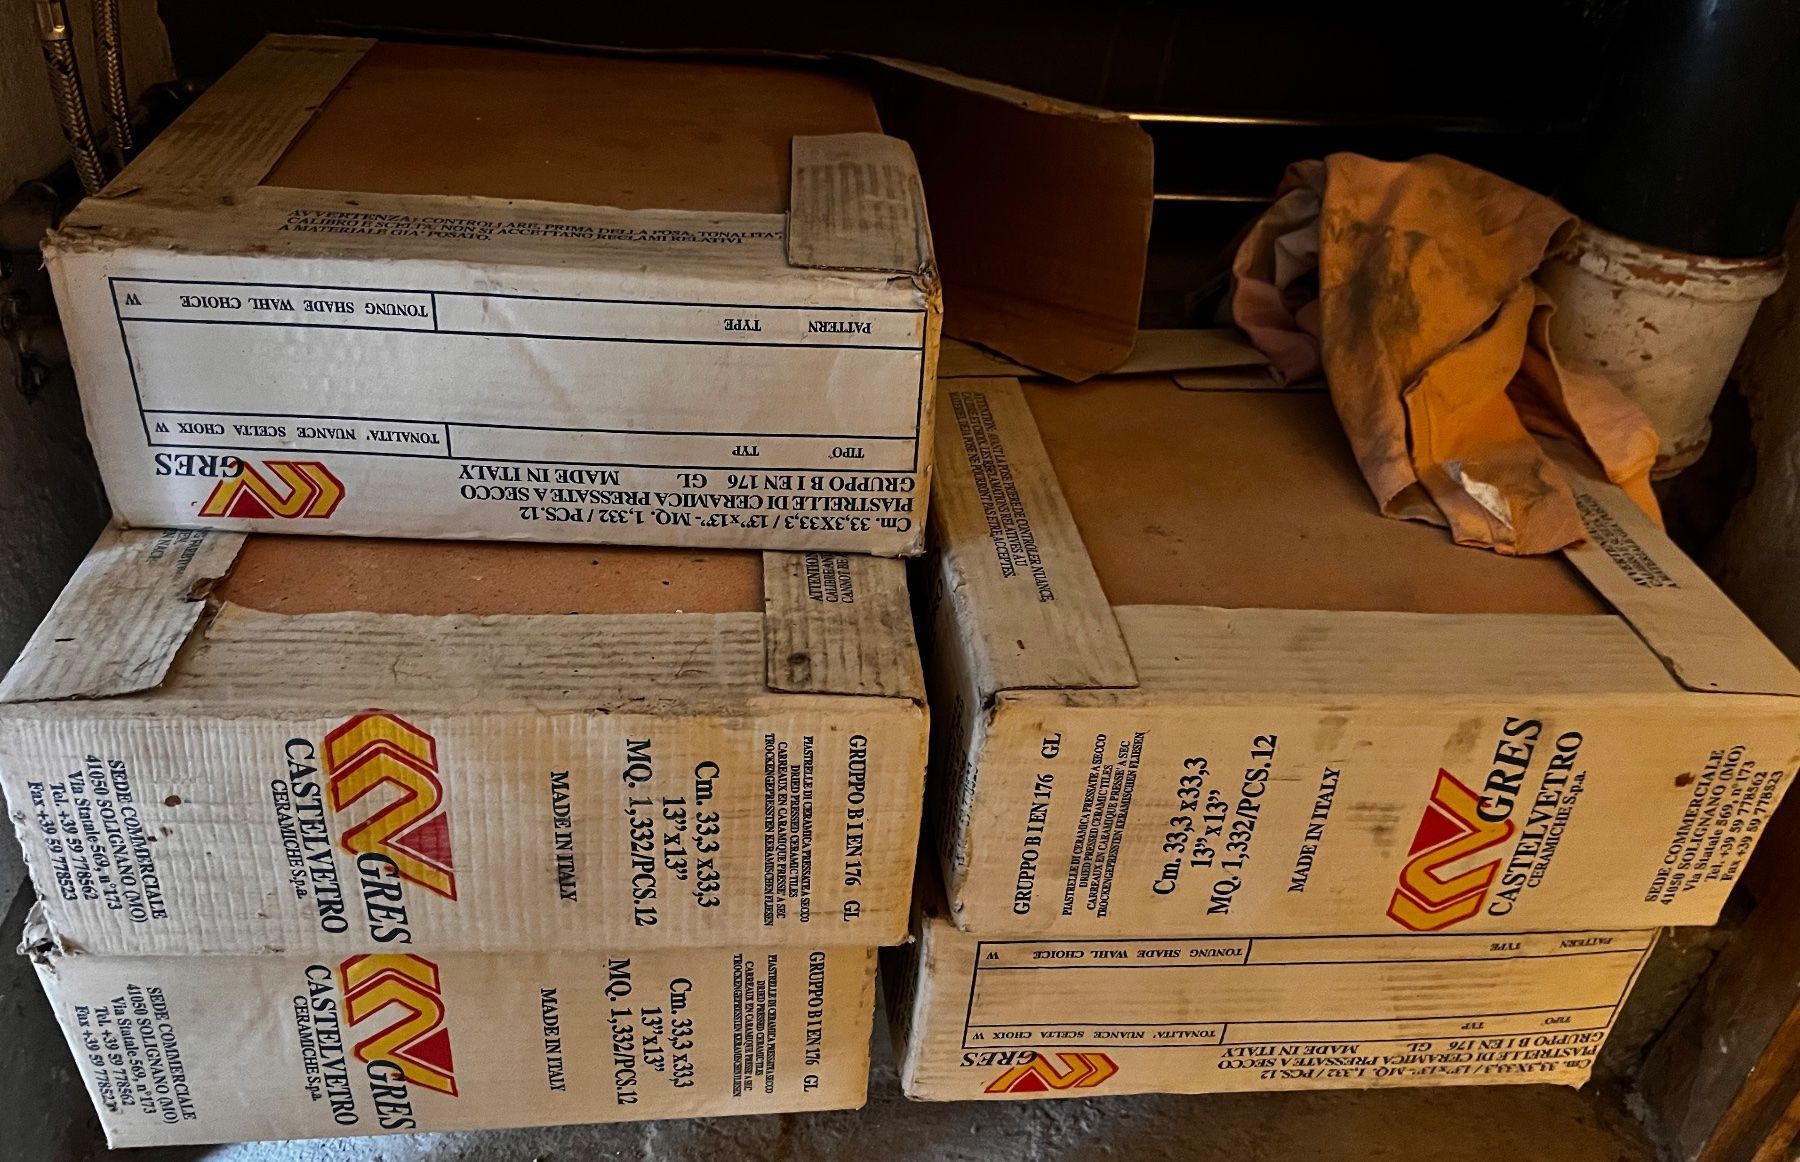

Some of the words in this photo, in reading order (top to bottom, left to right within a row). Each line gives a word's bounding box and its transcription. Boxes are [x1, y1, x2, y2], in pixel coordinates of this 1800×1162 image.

[125, 293, 142, 305] W
[179, 295, 242, 309] CHOICE
[248, 298, 295, 311] WAHL
[303, 300, 355, 314] SHADE
[364, 302, 428, 317] TONUNG
[724, 318, 762, 332] TYPE
[808, 320, 872, 334] PATTERN
[155, 422, 170, 433] W
[177, 423, 225, 435] CHOIX
[232, 424, 286, 437] SCELTA
[296, 427, 357, 440] NUANCE
[366, 430, 440, 444] TONALITA'
[155, 452, 246, 478] GRES
[458, 464, 522, 482] ITALY
[527, 467, 550, 483] IN
[554, 469, 621, 486] MADE
[676, 473, 707, 488] GL
[727, 474, 759, 489] 176
[763, 475, 793, 491] EN
[797, 476, 806, 490] I
[810, 476, 824, 491] B
[829, 476, 915, 493] GRUPPO
[460, 484, 530, 502] SECCO
[550, 488, 651, 506] PRESSATE
[653, 492, 763, 510] CERAMICA
[767, 495, 789, 510] DI
[791, 495, 915, 513] PIASTRELLE
[519, 506, 584, 522] PCS.12
[598, 508, 644, 525] 1,332
[650, 508, 692, 526] MQ.
[784, 513, 871, 532] 33,3X33,3
[875, 517, 912, 533] Cm.
[1041, 733, 1062, 759] GL
[1091, 734, 1107, 765] SECCO
[85, 754, 110, 795] 41050
[622, 739, 653, 788] MQ.
[803, 736, 814, 789] PIASTRELLE
[847, 735, 868, 805] GRUPPO
[1476, 716, 1544, 822] GRES
[694, 761, 720, 806] Cm.
[1034, 773, 1054, 799] 176
[1081, 772, 1099, 813] PRESSATE
[1311, 766, 1341, 820] ITALY
[550, 770, 571, 829] MADE
[847, 808, 864, 820] B
[1028, 801, 1049, 823] EN
[1488, 732, 1583, 916] CASTELVETRO
[74, 798, 101, 843] Statale
[90, 845, 111, 872] 569,
[285, 738, 349, 934] CASTELVETRO
[691, 811, 720, 853] 33,3
[802, 801, 813, 849] CERAMICA
[846, 822, 864, 832] I
[1026, 825, 1044, 833] I
[1072, 814, 1091, 855] CERAMICA
[1163, 816, 1195, 854] 33,3
[1304, 822, 1325, 842] IN
[1527, 806, 1573, 888] CERAMICHE
[1562, 770, 1587, 805] S.p.a.
[1644, 867, 1672, 902] SEDE
[1664, 749, 1725, 864] COMMERCIALE
[1660, 873, 1686, 905] 41050
[1677, 785, 1727, 870] SOLIGNANO
[1718, 745, 1746, 781] (MO)
[1704, 861, 1725, 882] Tel.
[1736, 771, 1768, 816] 778562
[1721, 860, 1742, 881] Fax
[1753, 770, 1784, 815] 778523
[27, 781, 45, 807] Fax
[51, 856, 78, 901] 778523
[49, 782, 69, 807] Tel.
[71, 856, 100, 900] 778562
[96, 799, 137, 886] SOLIGNANO
[107, 759, 133, 804] SEDE
[120, 806, 168, 919] COMMERCIALE
[271, 779, 304, 867] CERAMICHE
[289, 869, 308, 899] S.p.a.
[555, 831, 573, 851] IN
[845, 833, 863, 857] EN
[1024, 836, 1041, 847] B
[1694, 829, 1723, 870] Statale
[556, 854, 577, 902] ITALY
[845, 861, 862, 886] 176
[1152, 858, 1182, 895] Cm.
[1287, 844, 1318, 893] MADE
[1013, 849, 1039, 915] GRUPPO
[1062, 865, 1079, 916] PIASTRELLE
[122, 890, 149, 923] (MO)
[354, 851, 413, 945] GRES
[1206, 876, 1242, 916] MQ.
[843, 900, 861, 922] GL
[1033, 950, 1084, 959] CHOICE
[1090, 950, 1128, 958] WAHL
[1137, 949, 1181, 958] SHADE
[1189, 948, 1243, 957] TONUNG
[602, 958, 632, 1002] MQ.
[808, 951, 826, 1008] GRUPPO
[126, 984, 149, 1015] 41050
[669, 978, 692, 1015] Cm.
[540, 988, 559, 1037] MADE
[293, 995, 320, 1075] CERAMICHE
[304, 965, 359, 1126] CASTELVETRO
[545, 1038, 562, 1054] IN
[667, 1018, 694, 1050] 33,3
[1040, 1031, 1085, 1039] SCELTA
[1093, 1031, 1145, 1039] NUANCE
[1153, 1030, 1216, 1039] TONALITA'
[1533, 1031, 1605, 1046] GRUPPO
[136, 1018, 170, 1094] SOLIGNANO
[146, 987, 170, 1020] SEDE
[158, 1023, 197, 1120] COMMERCIALE
[958, 1049, 1039, 1068] GRES
[1221, 1046, 1276, 1058] ITALY
[1278, 1045, 1301, 1056] IN
[1303, 1045, 1360, 1055] MADE
[546, 1056, 566, 1091] ITALY
[305, 1076, 322, 1102] S.p.a.
[364, 1059, 418, 1130] GRES
